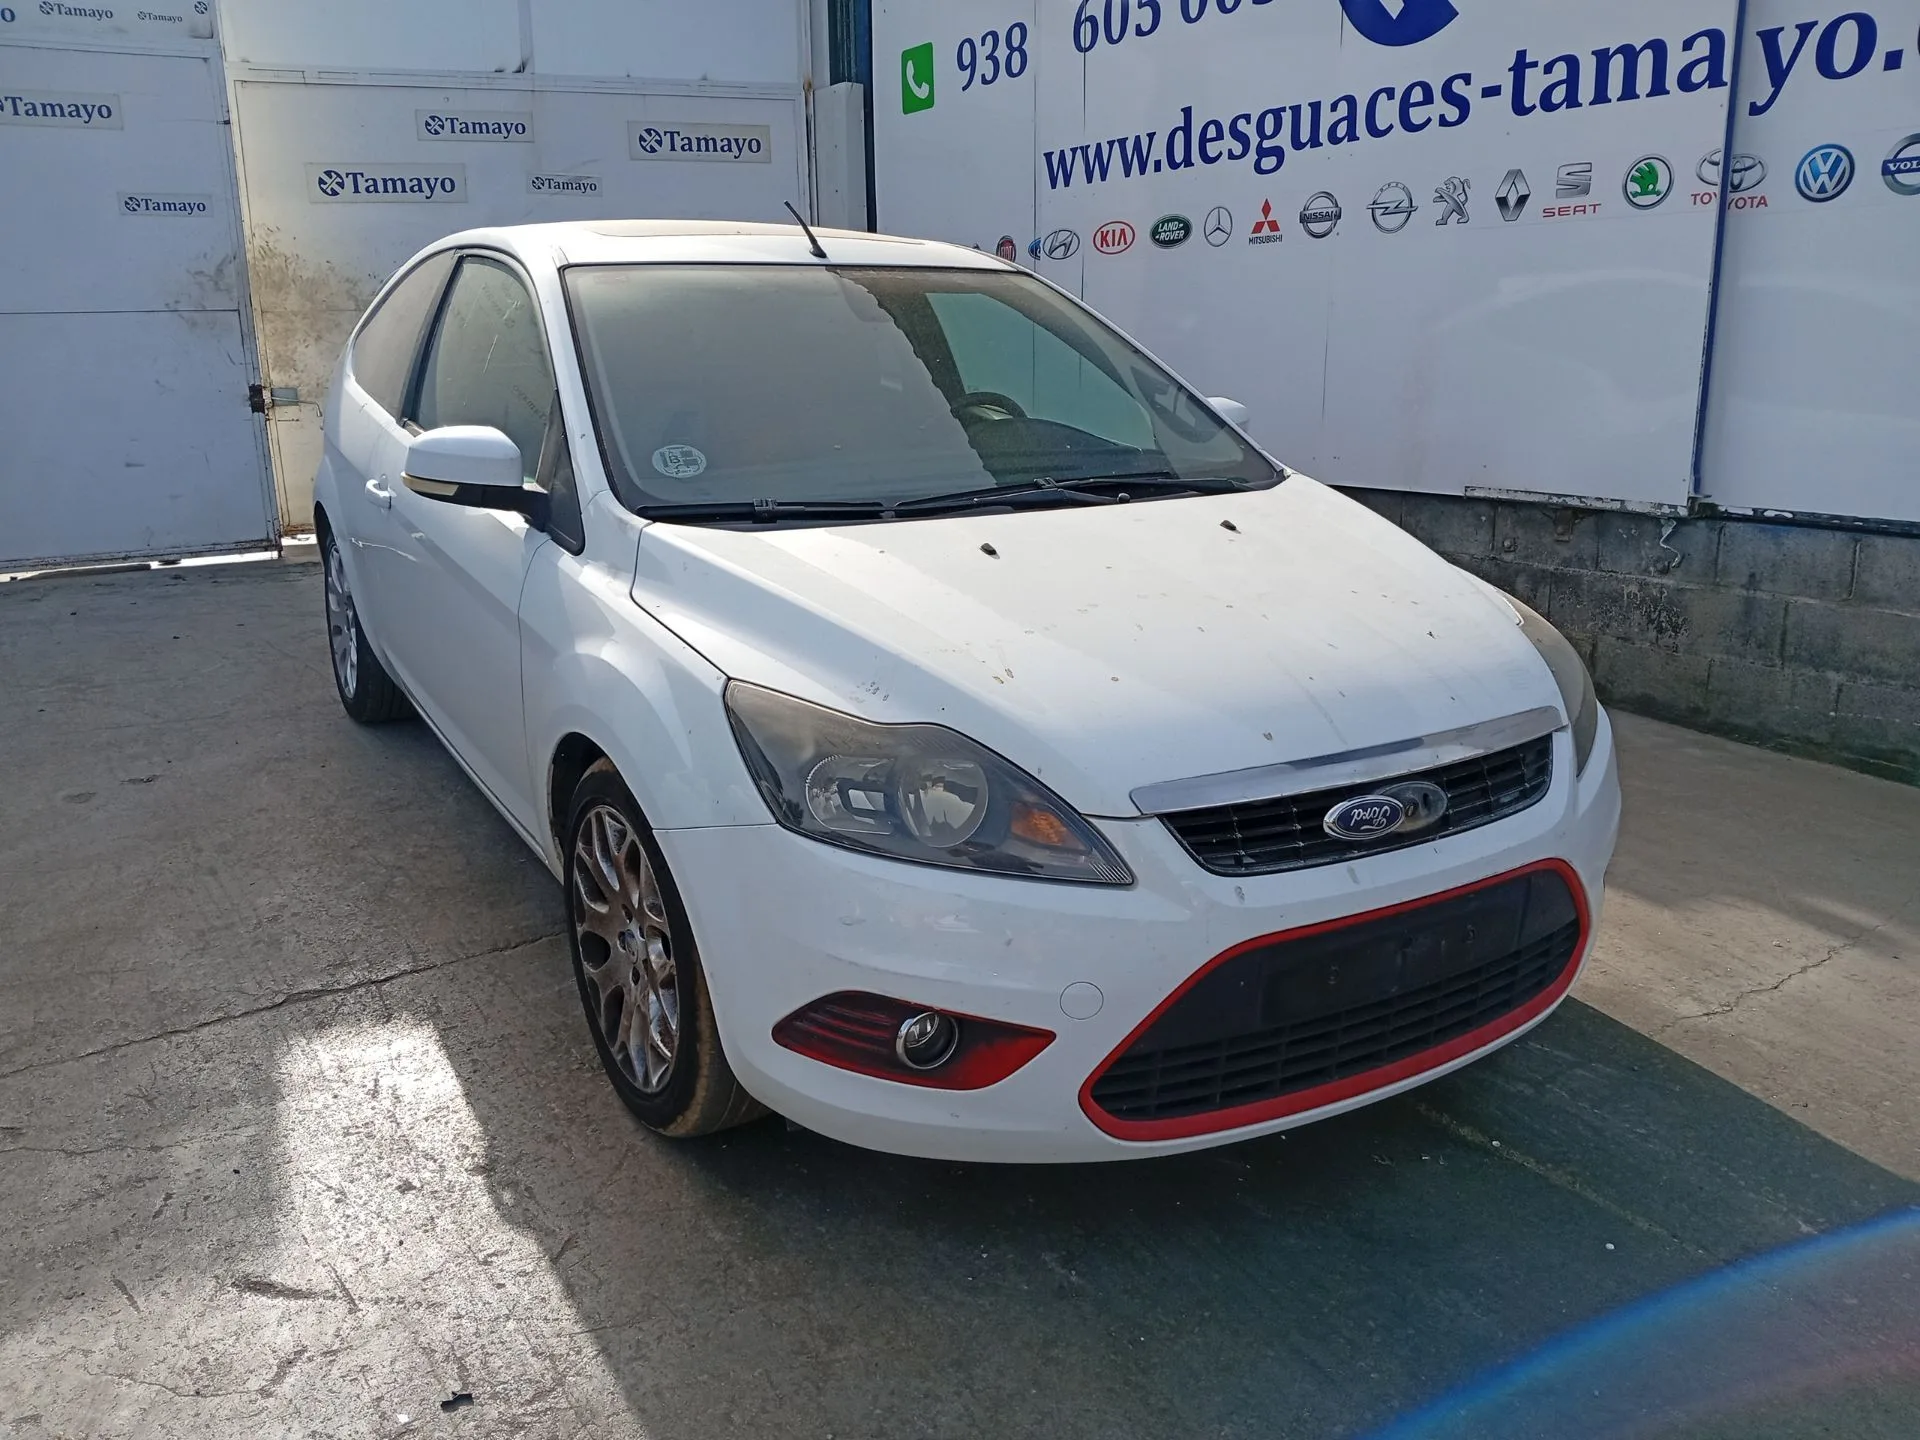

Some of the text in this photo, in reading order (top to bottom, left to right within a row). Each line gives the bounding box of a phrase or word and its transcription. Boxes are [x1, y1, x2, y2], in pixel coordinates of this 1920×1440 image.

[54, 2, 114, 21] Tamayo
[147, 12, 183, 24] Tamayo
[957, 22, 1028, 91] 938
[5, 96, 113, 124] Tamayo
[1044, 10, 1920, 190] www.desguaces-tamayo.
[445, 117, 527, 139] Tamayo
[664, 131, 762, 159] Tamayo
[346, 173, 456, 199] Tamayo
[544, 177, 597, 194] Tamayo
[141, 198, 206, 215] Tamayo
[1303, 210, 1338, 220] NISSAN
[1542, 203, 1601, 218] SEAT
[1100, 228, 1128, 248] KIA
[1248, 234, 1283, 245] MITSUBISHI
[1349, 805, 1391, 830] Ford
